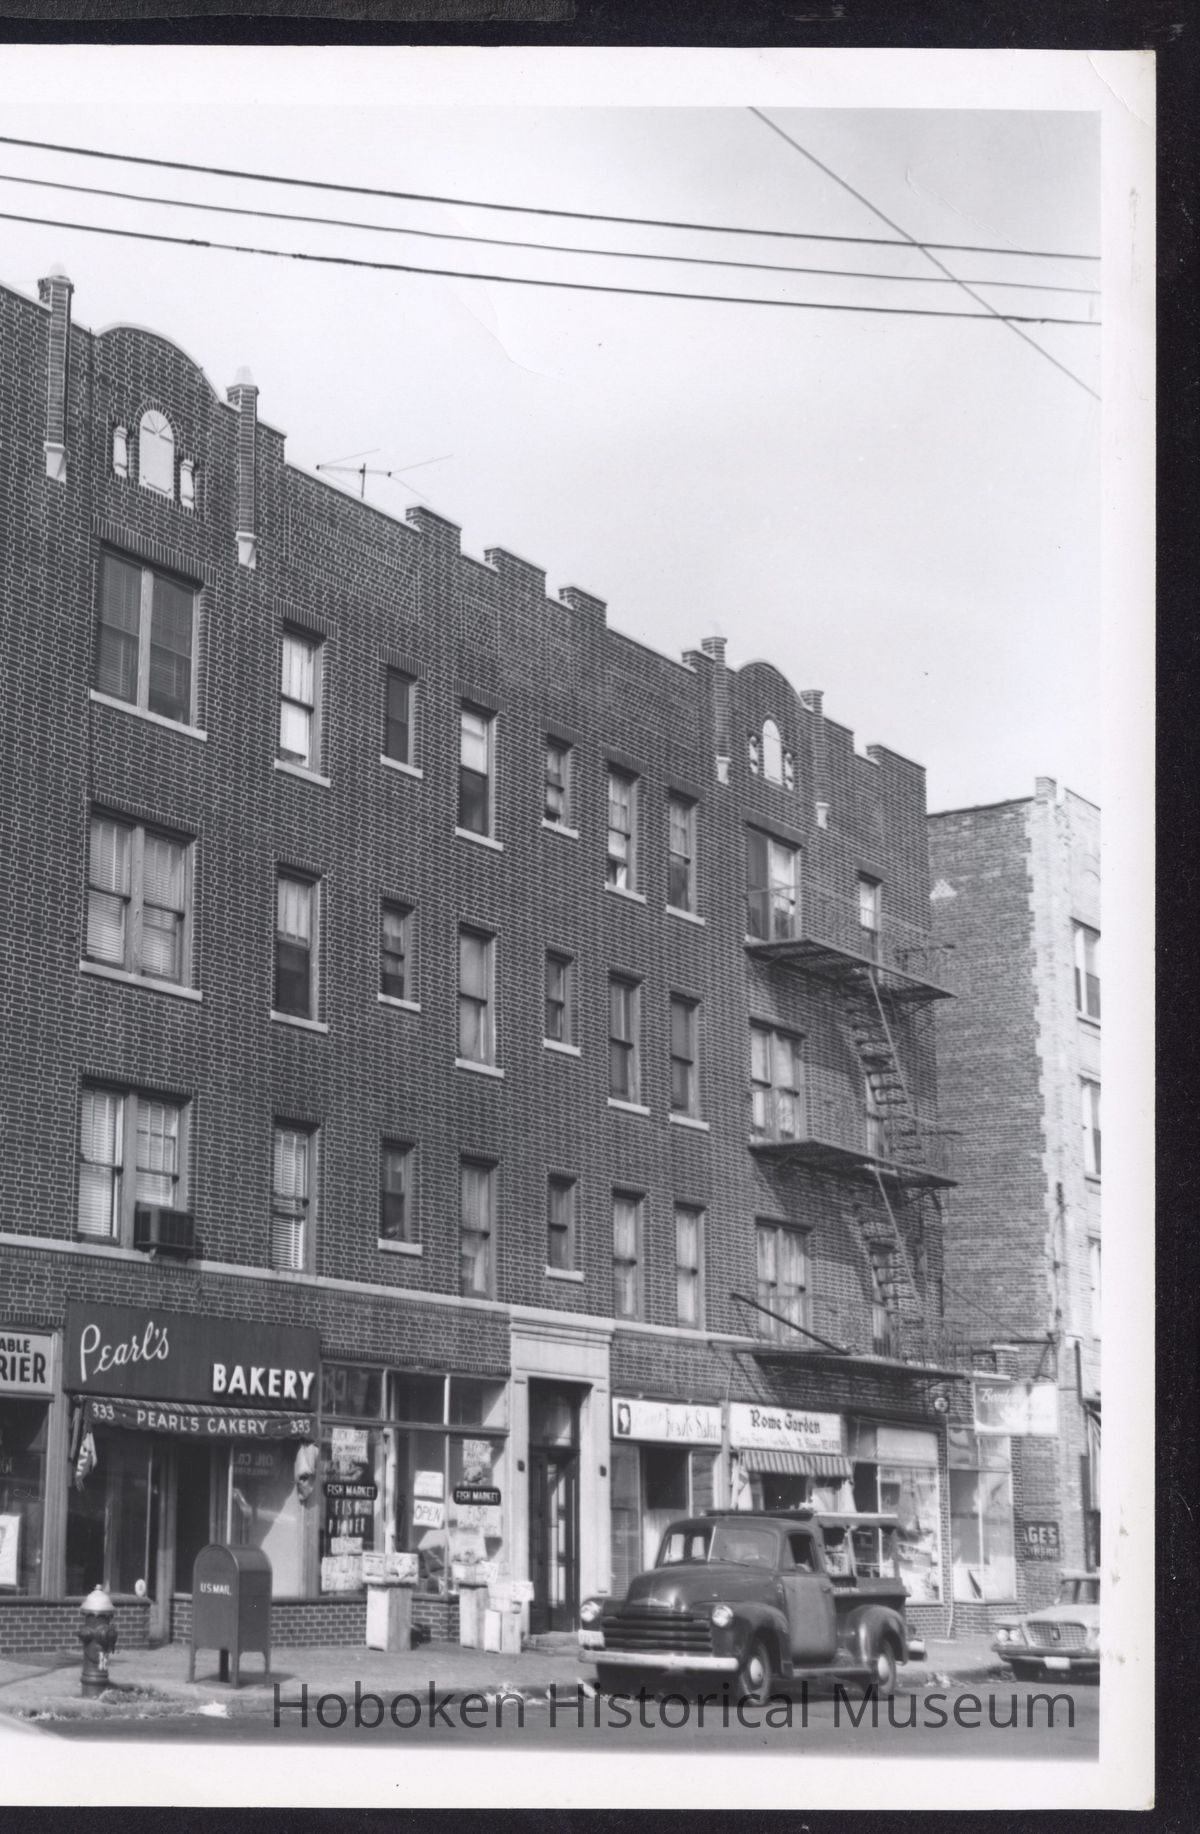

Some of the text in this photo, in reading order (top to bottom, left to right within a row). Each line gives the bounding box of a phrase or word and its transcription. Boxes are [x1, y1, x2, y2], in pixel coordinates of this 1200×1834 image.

[80, 1321, 169, 1383] Pearl's
[212, 1363, 315, 1400] BAKERY
[92, 1402, 311, 1434] 333 PEARL'S CAKERY 333
[750, 1409, 821, 1434] Rome Garden
[327, 1484, 375, 1498] FISH MARKET
[456, 1490, 499, 1503] FISH MARKET
[415, 1505, 441, 1521] OPEN
